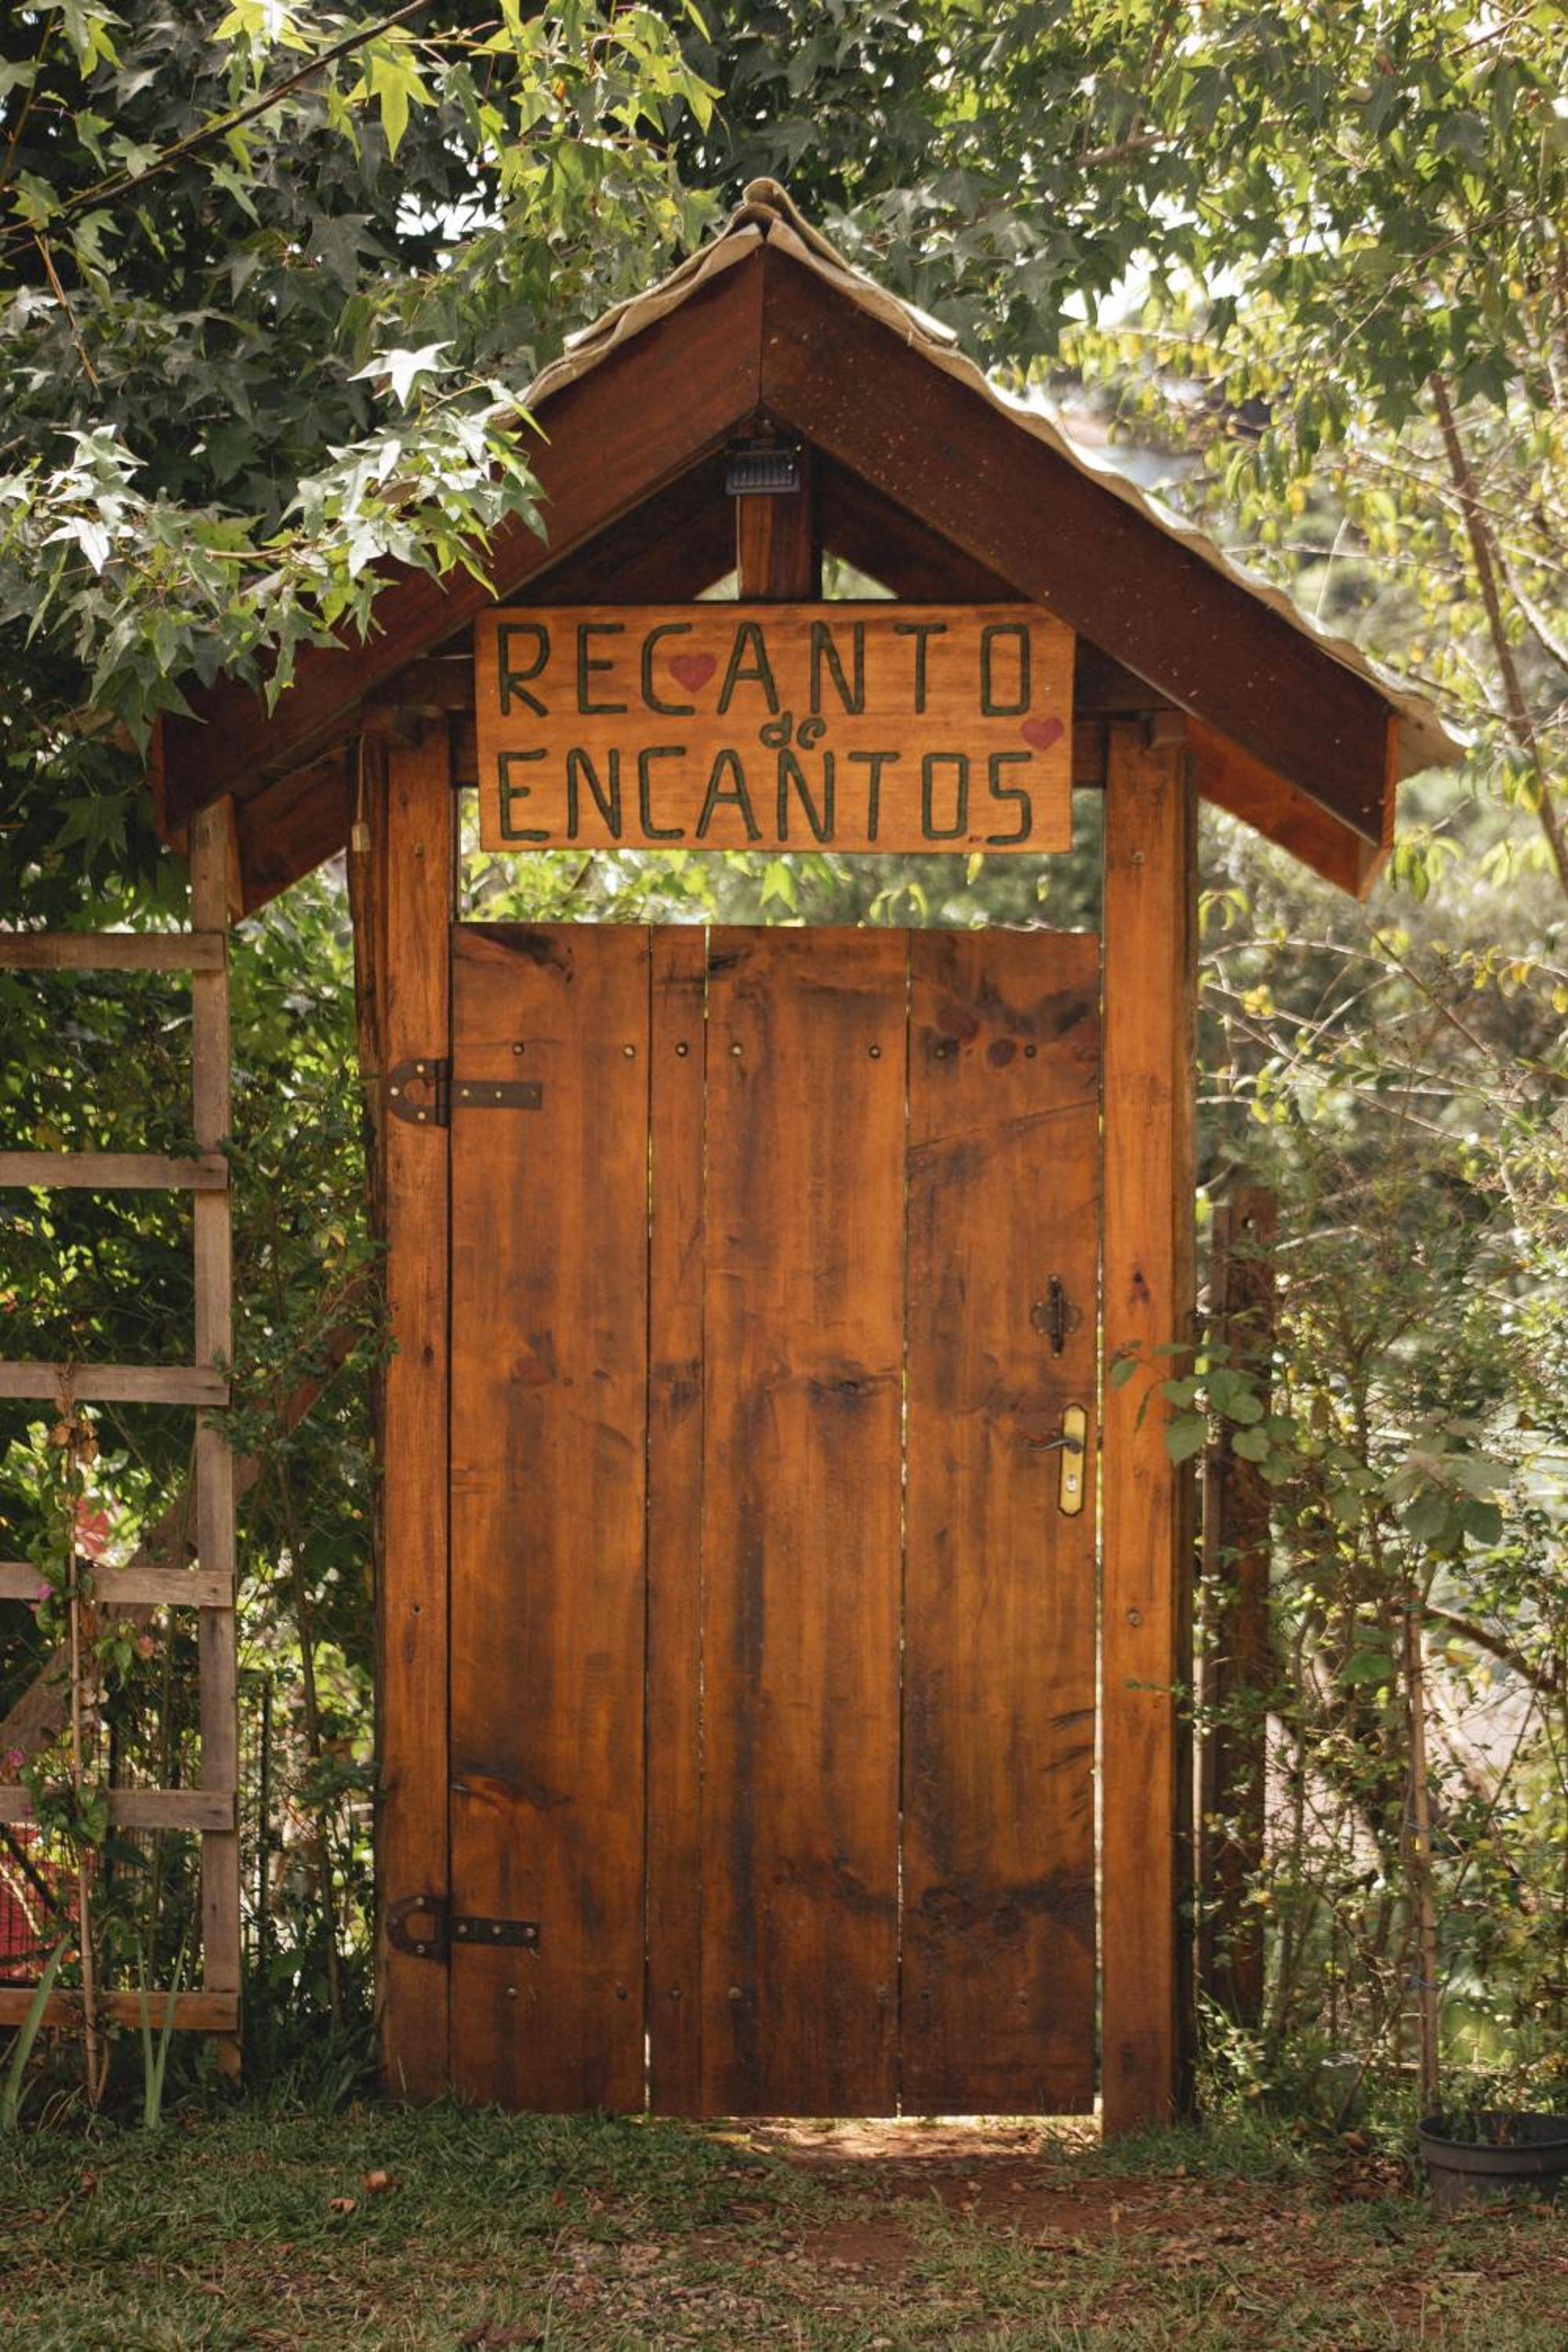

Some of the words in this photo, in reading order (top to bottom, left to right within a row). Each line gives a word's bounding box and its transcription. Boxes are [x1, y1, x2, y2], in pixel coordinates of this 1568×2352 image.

[498, 620, 1030, 717] RECANTO
[759, 710, 826, 750] de
[498, 747, 1033, 845] ENCANTOS
